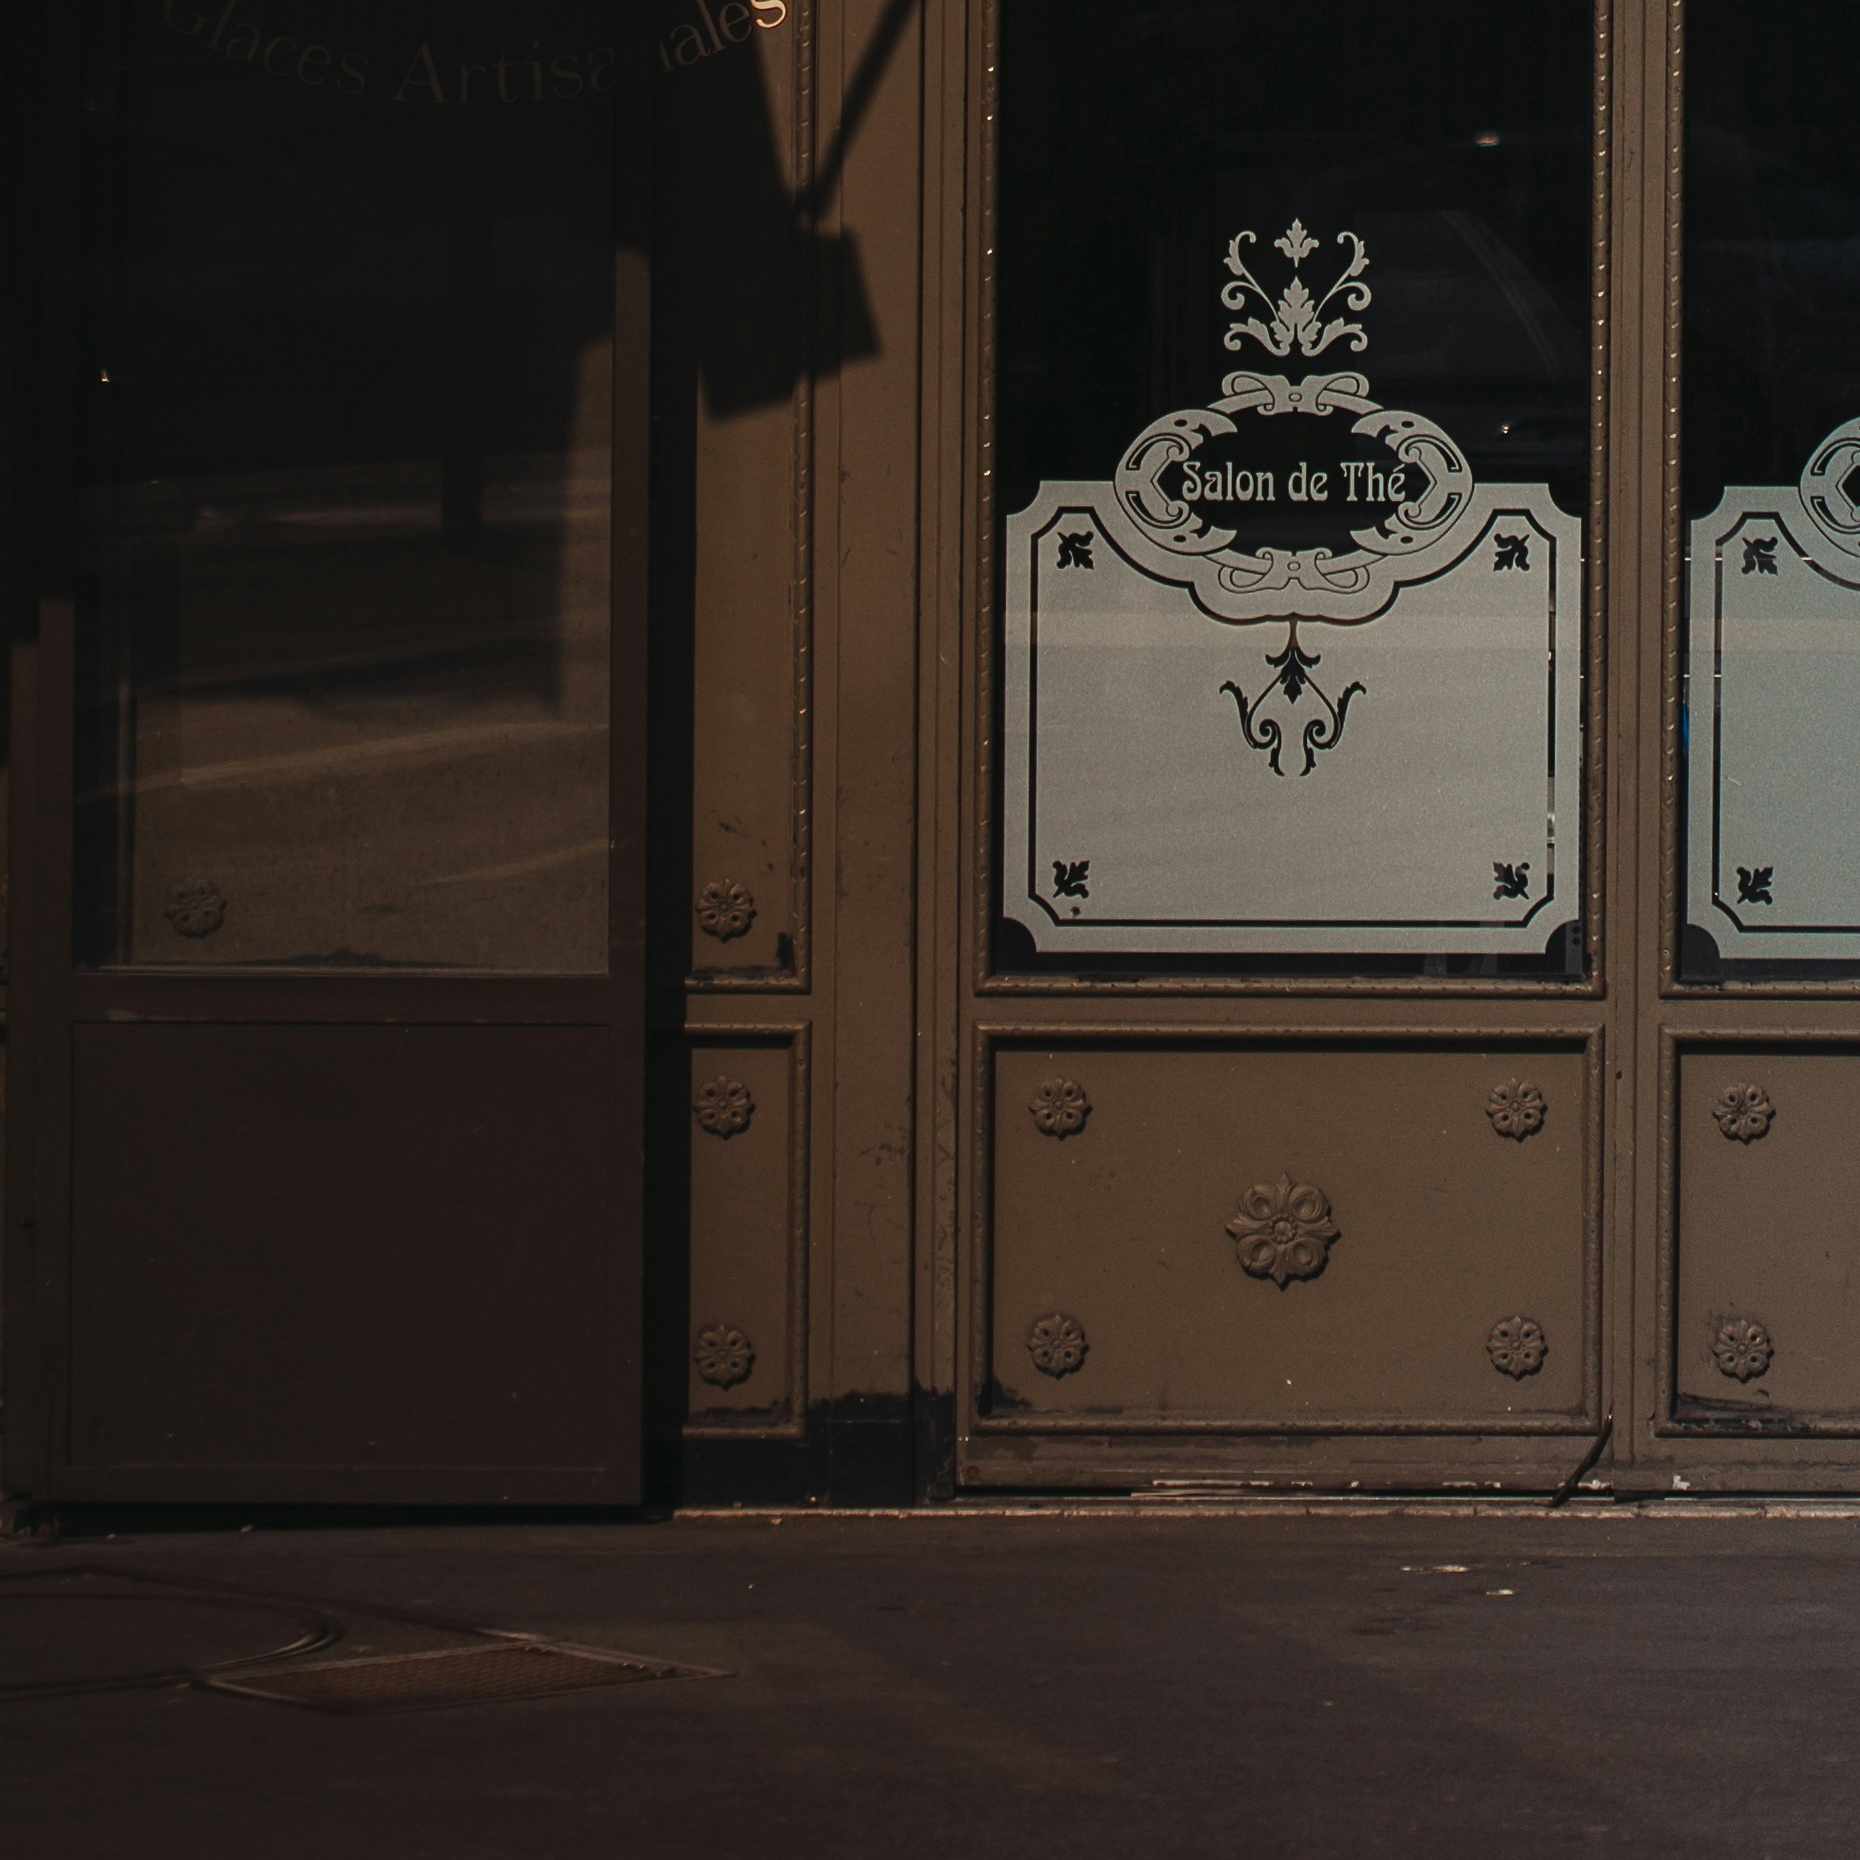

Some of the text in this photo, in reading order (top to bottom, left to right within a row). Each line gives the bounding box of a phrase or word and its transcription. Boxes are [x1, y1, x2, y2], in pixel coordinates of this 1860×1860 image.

[1182, 461, 1406, 502] Salon de Thé
